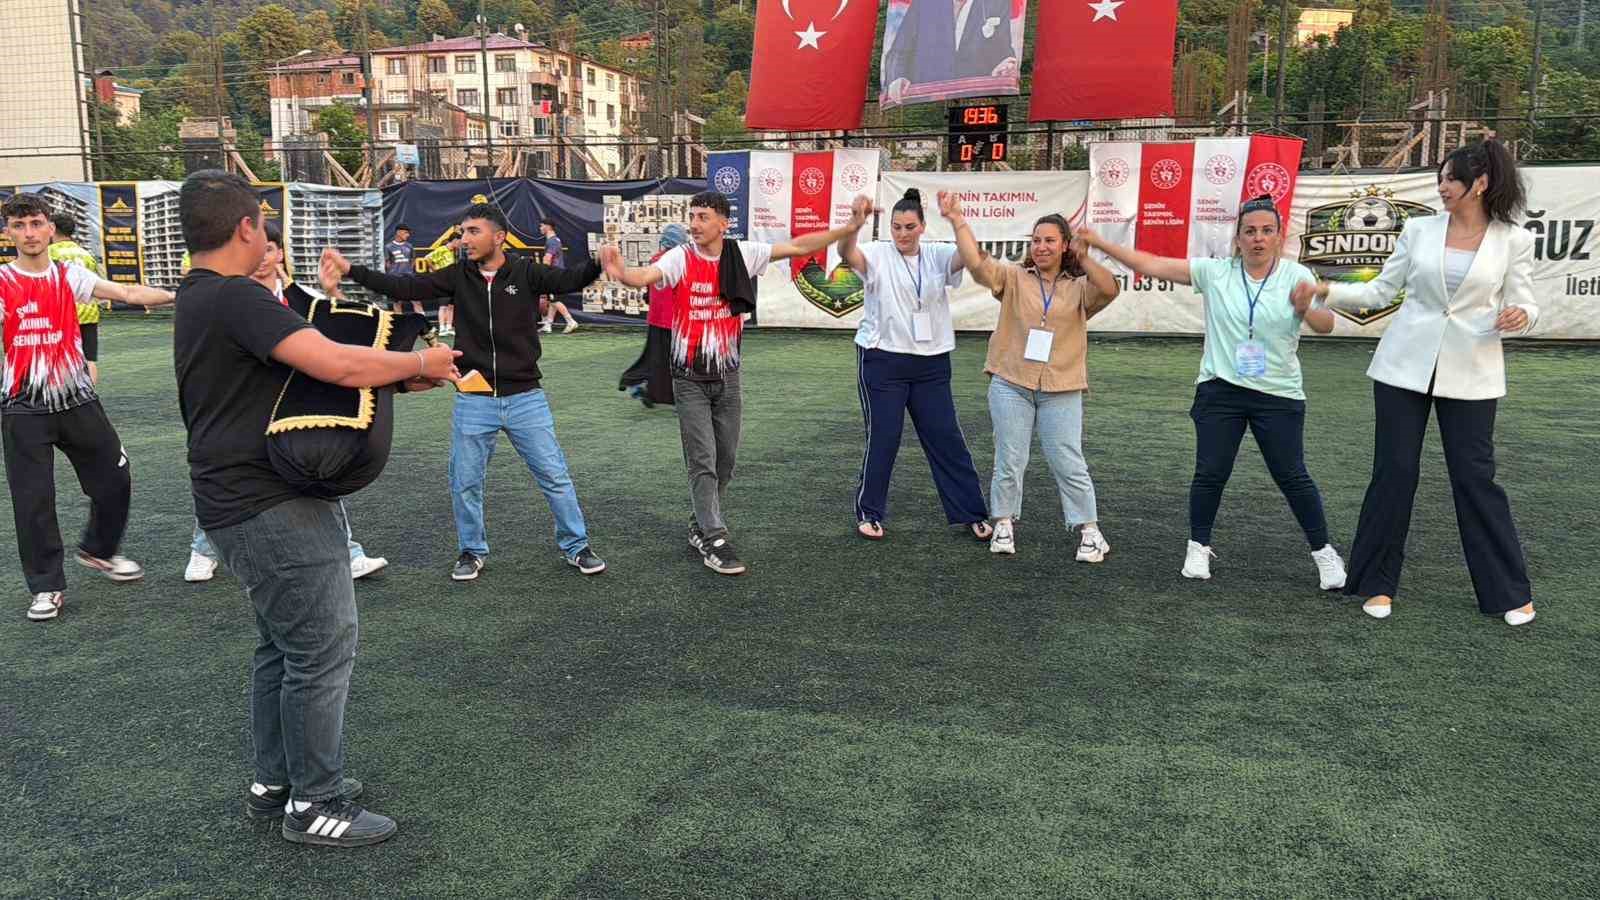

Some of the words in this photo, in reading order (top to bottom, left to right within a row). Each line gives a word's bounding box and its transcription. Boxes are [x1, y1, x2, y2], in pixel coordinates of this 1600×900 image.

[958, 134, 967, 144] A
[961, 144, 973, 161] 0
[992, 143, 1004, 160] 0
[951, 189, 980, 202] ENİN
[983, 205, 1015, 217] LİGİN
